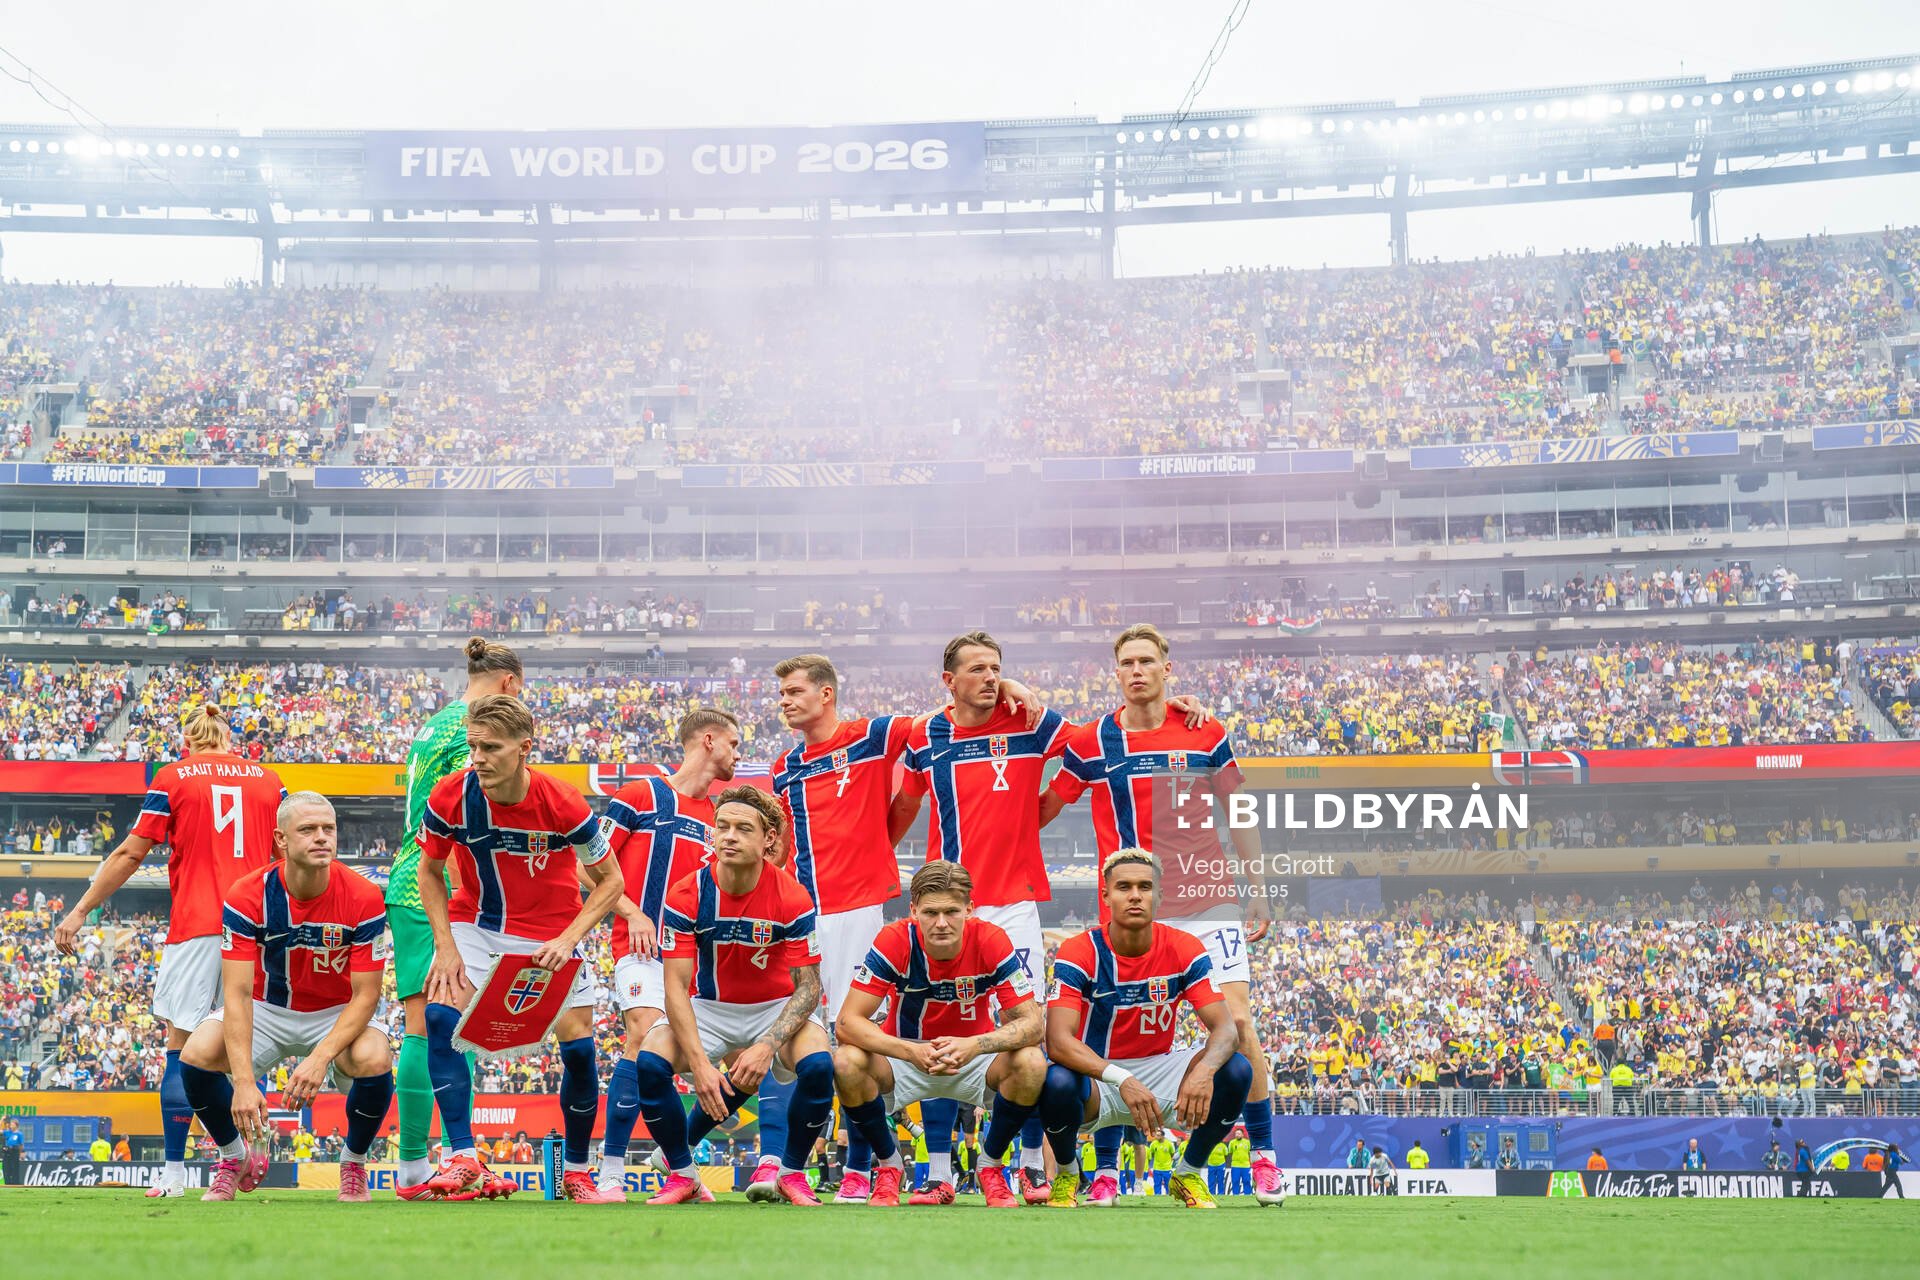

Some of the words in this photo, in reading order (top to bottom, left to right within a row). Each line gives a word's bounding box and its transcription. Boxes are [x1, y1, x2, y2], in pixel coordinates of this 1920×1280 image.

[400, 147, 491, 177] FIFA
[510, 147, 664, 177] WORLD
[692, 144, 776, 176] CUP
[797, 139, 949, 173] 2026
[52, 465, 166, 486] #FIFAWorldCup
[1139, 455, 1256, 475] #FIFAWorldCup
[177, 763, 212, 780] BRAUT
[216, 764, 264, 778] HAALAND
[1286, 766, 1321, 780] BRAZIL
[1756, 755, 1803, 769] NORWAY
[836, 766, 851, 797] 7
[991, 760, 1009, 791] 8
[1168, 777, 1196, 809] 17
[211, 784, 244, 858] 9
[524, 852, 550, 878] 10
[1216, 928, 1241, 959] 17
[313, 949, 348, 974] 26
[960, 1002, 976, 1021] 5
[1140, 1004, 1173, 1035] 20
[471, 1108, 516, 1124] ORWAY
[24, 1163, 71, 1186] Unite
[71, 1165, 99, 1186] For
[554, 1146, 563, 1197] POWERADE
[1407, 1180, 1449, 1194] FIFA
[1595, 1172, 1644, 1198] Unite
[1645, 1173, 1674, 1198] For
[1677, 1175, 1783, 1198] EDUCATION
[1791, 1181, 1835, 1197] FFA
